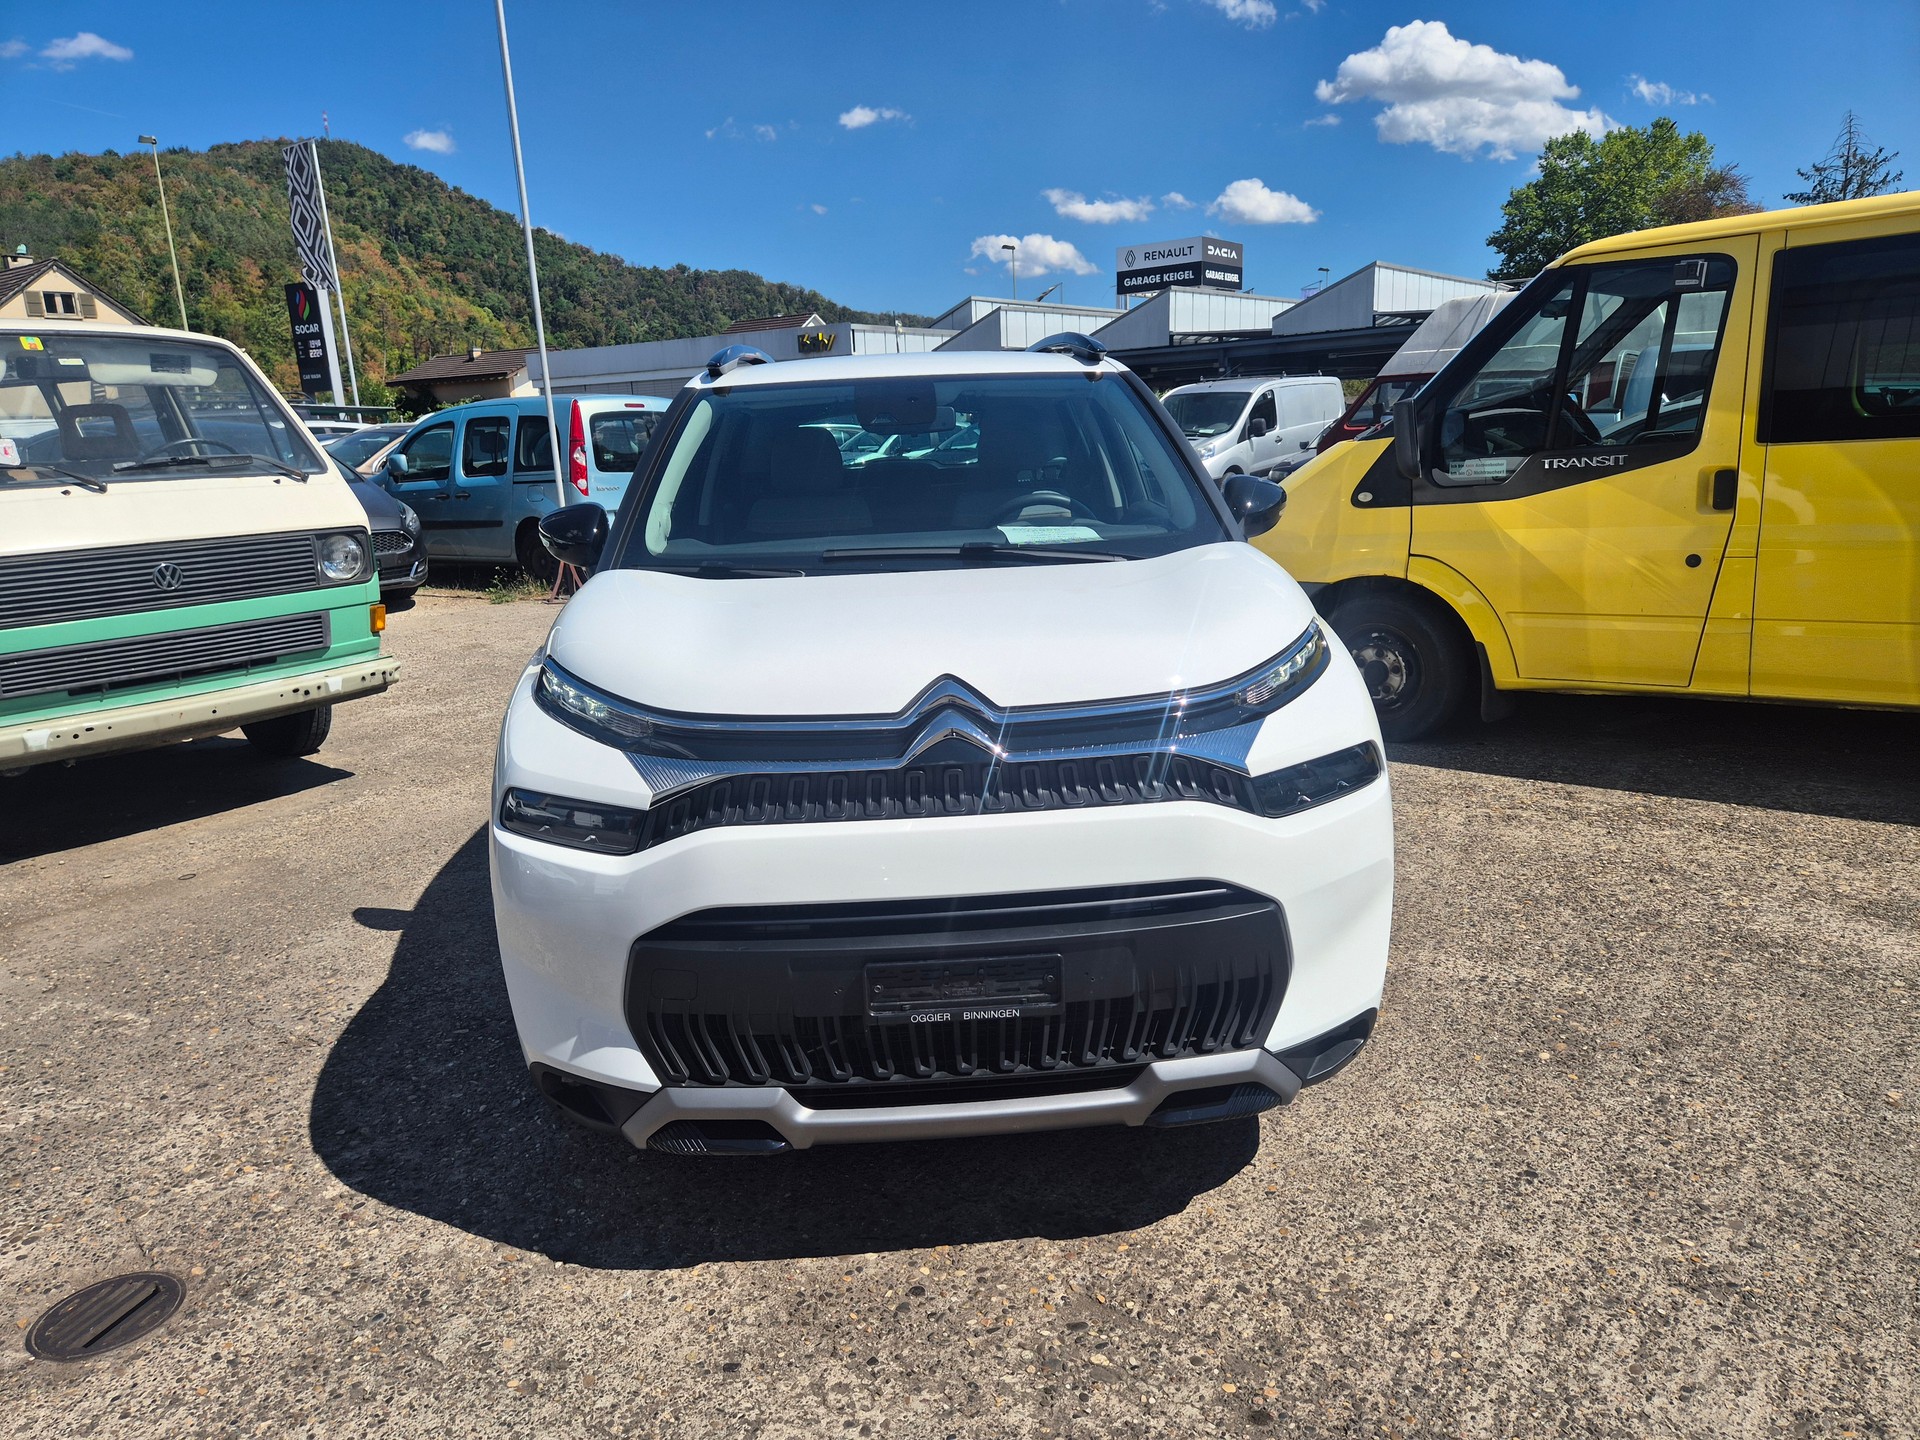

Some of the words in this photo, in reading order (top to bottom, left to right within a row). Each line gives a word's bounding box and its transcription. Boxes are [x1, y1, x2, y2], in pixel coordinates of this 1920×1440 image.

[1144, 246, 1194, 261] RENAULT
[1207, 245, 1238, 259] DACIA
[1124, 274, 1161, 287] GARAGE
[1163, 270, 1194, 282] KEIGEL
[1205, 269, 1225, 281] GARAGE
[1225, 272, 1240, 283] KEIGEL
[295, 323, 319, 334] SOCAR
[1541, 454, 1628, 469] TRANSIT
[910, 1012, 951, 1024] OGGIER
[963, 1008, 1020, 1021] BINNINGEN
